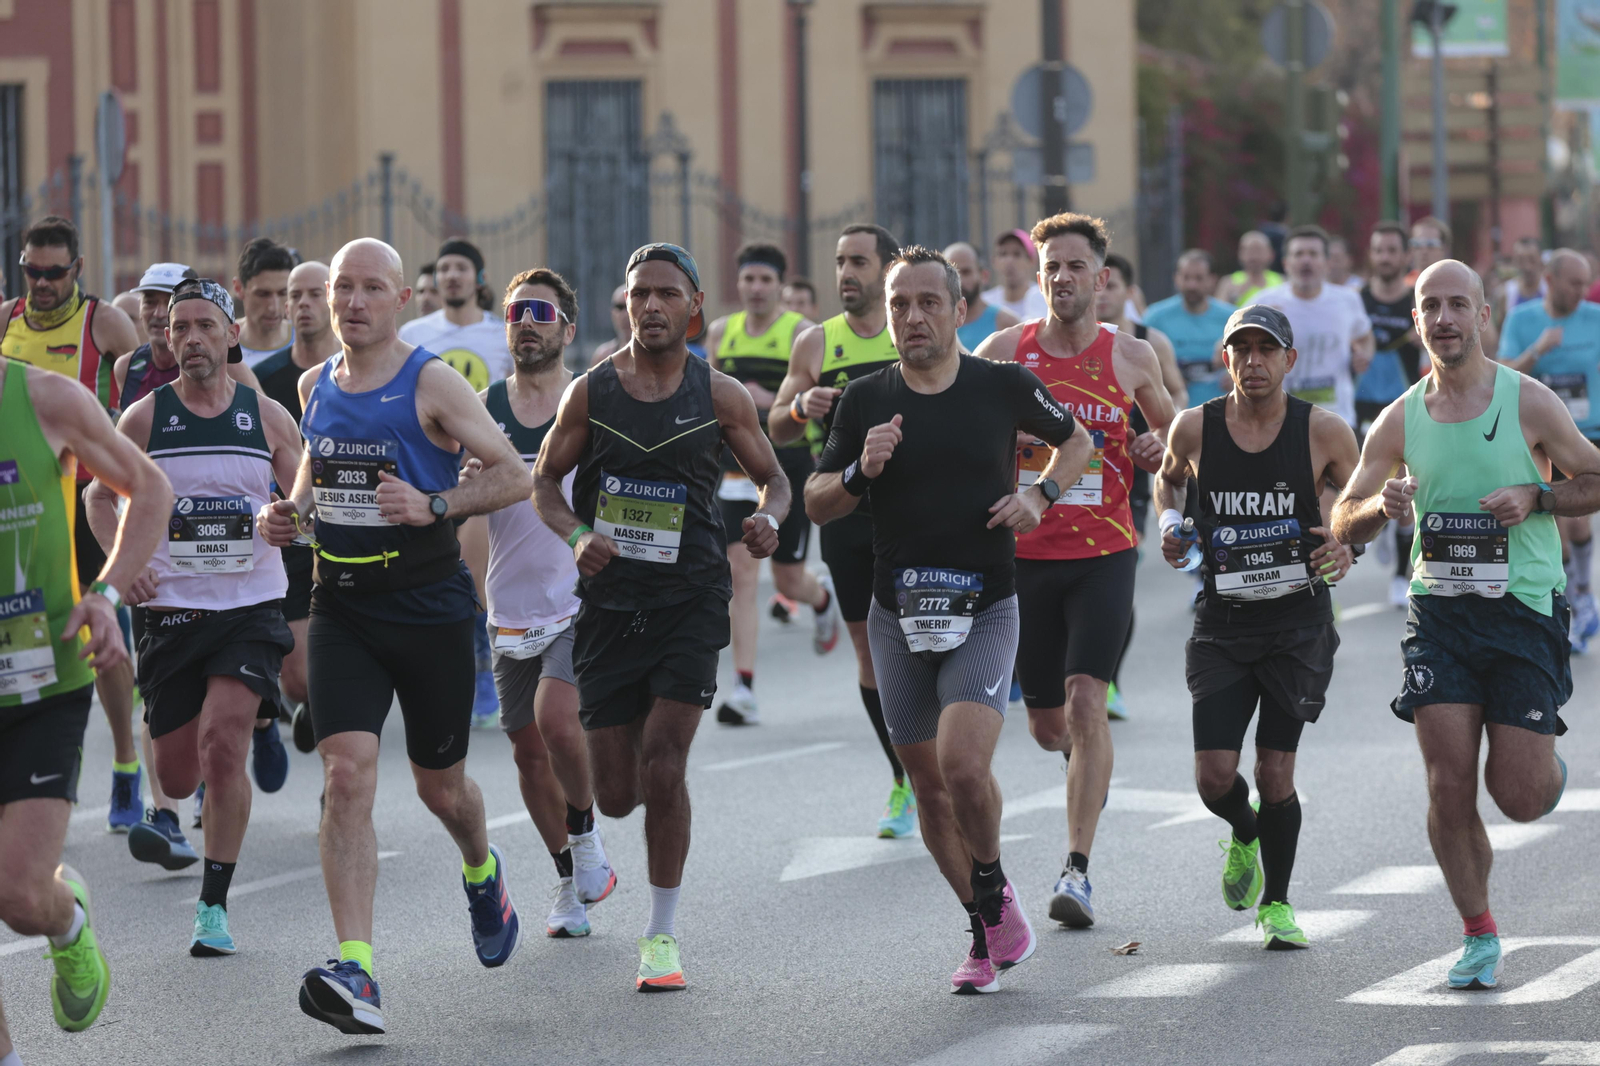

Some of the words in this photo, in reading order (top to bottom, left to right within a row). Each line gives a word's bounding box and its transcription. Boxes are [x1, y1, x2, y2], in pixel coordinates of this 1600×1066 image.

[1034, 388, 1064, 421] salomon
[162, 424, 186, 433] VIATOR
[338, 443, 386, 456] ZURICH
[337, 470, 367, 484] 2033
[319, 491, 345, 503] JESUS
[624, 483, 675, 498] ZURICH
[197, 500, 244, 511] ZURICH
[1210, 491, 1295, 516] VIKRAM
[622, 508, 652, 523] 1327
[197, 524, 226, 536] 3065
[1446, 518, 1497, 529] ZURICH
[614, 527, 654, 542] NASSER
[1240, 524, 1289, 541] ZURICH
[196, 543, 228, 553] IGNASI
[1448, 544, 1477, 558] 1969
[1243, 551, 1274, 566] 1945
[1242, 570, 1281, 584] VIKRAM
[1450, 566, 1474, 577] ALEX
[920, 571, 971, 587] ZURICH
[919, 597, 950, 611] 2772
[914, 619, 952, 630] THIERRY
